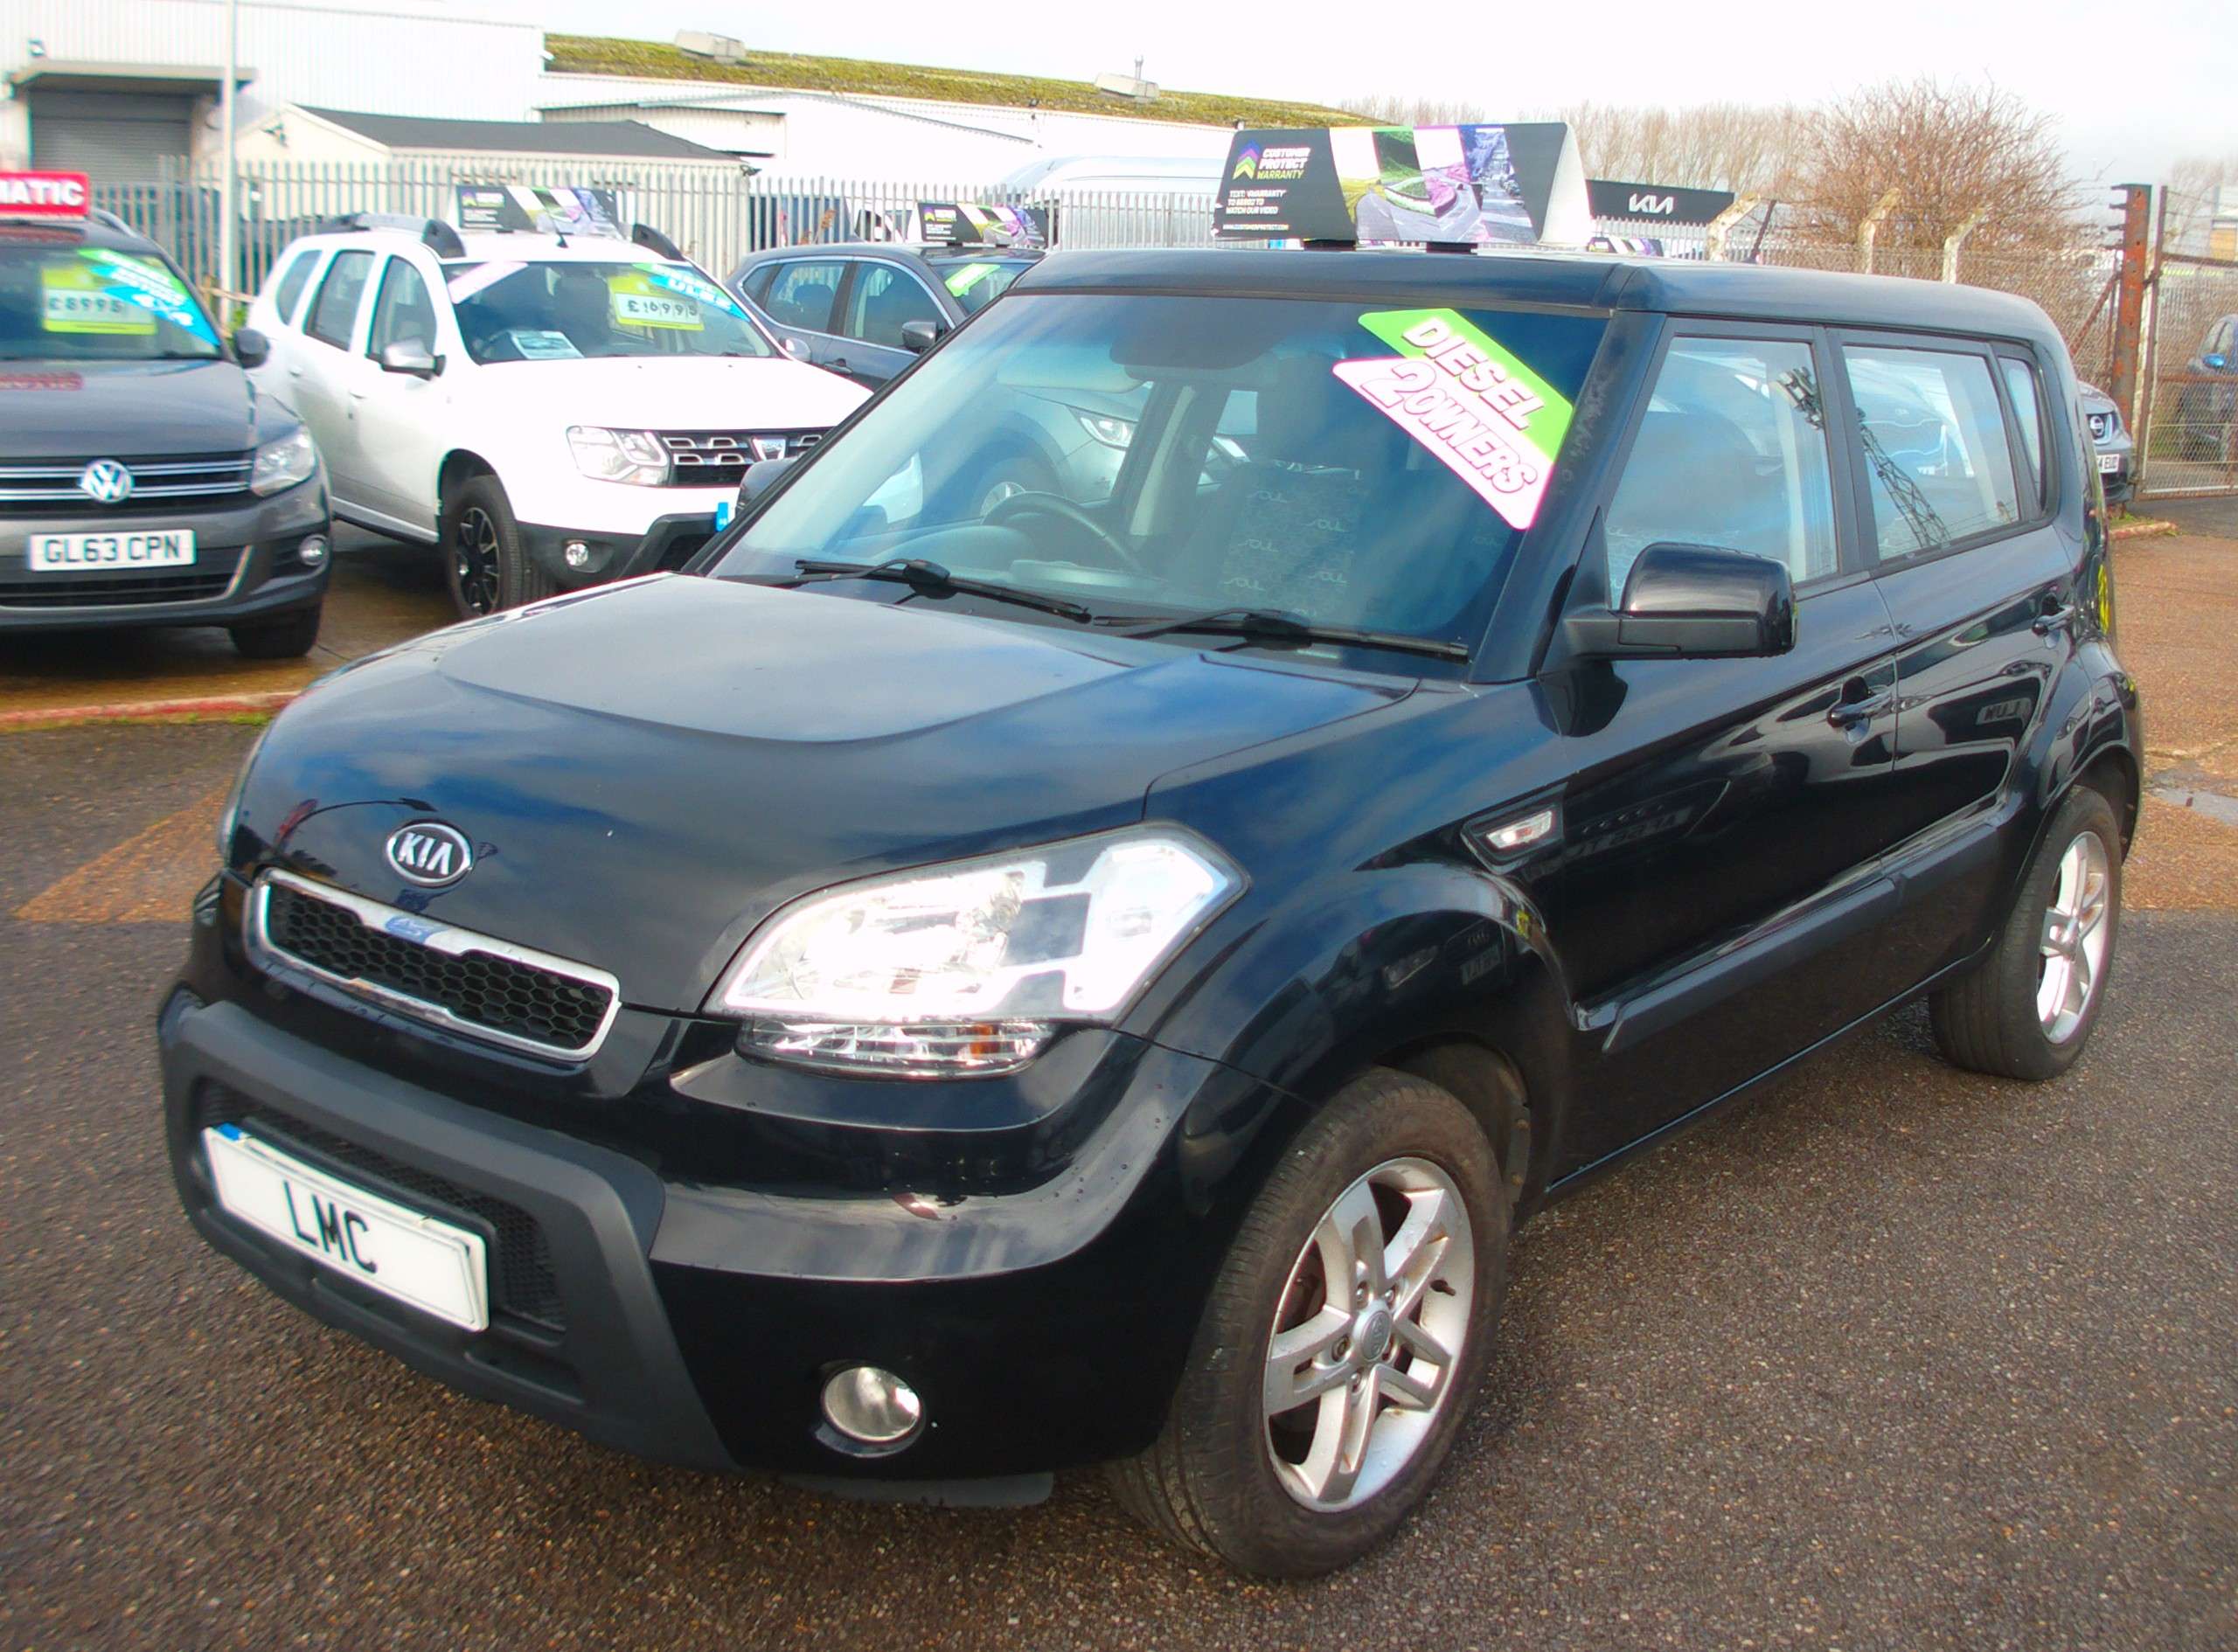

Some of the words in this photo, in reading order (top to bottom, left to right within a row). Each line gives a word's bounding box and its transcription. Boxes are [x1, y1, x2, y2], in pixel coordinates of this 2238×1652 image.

[1257, 170, 1305, 179] WARRANTY
[1259, 157, 1308, 170] PROTECT
[1629, 193, 1674, 215] KIA
[1401, 317, 1544, 431] DIESEL
[1359, 360, 1437, 409] 2
[1403, 387, 1539, 493] OWNERS
[45, 538, 118, 564] GL63
[127, 535, 180, 561] CPN
[398, 831, 454, 876] KIA
[282, 1179, 379, 1274] LMC
